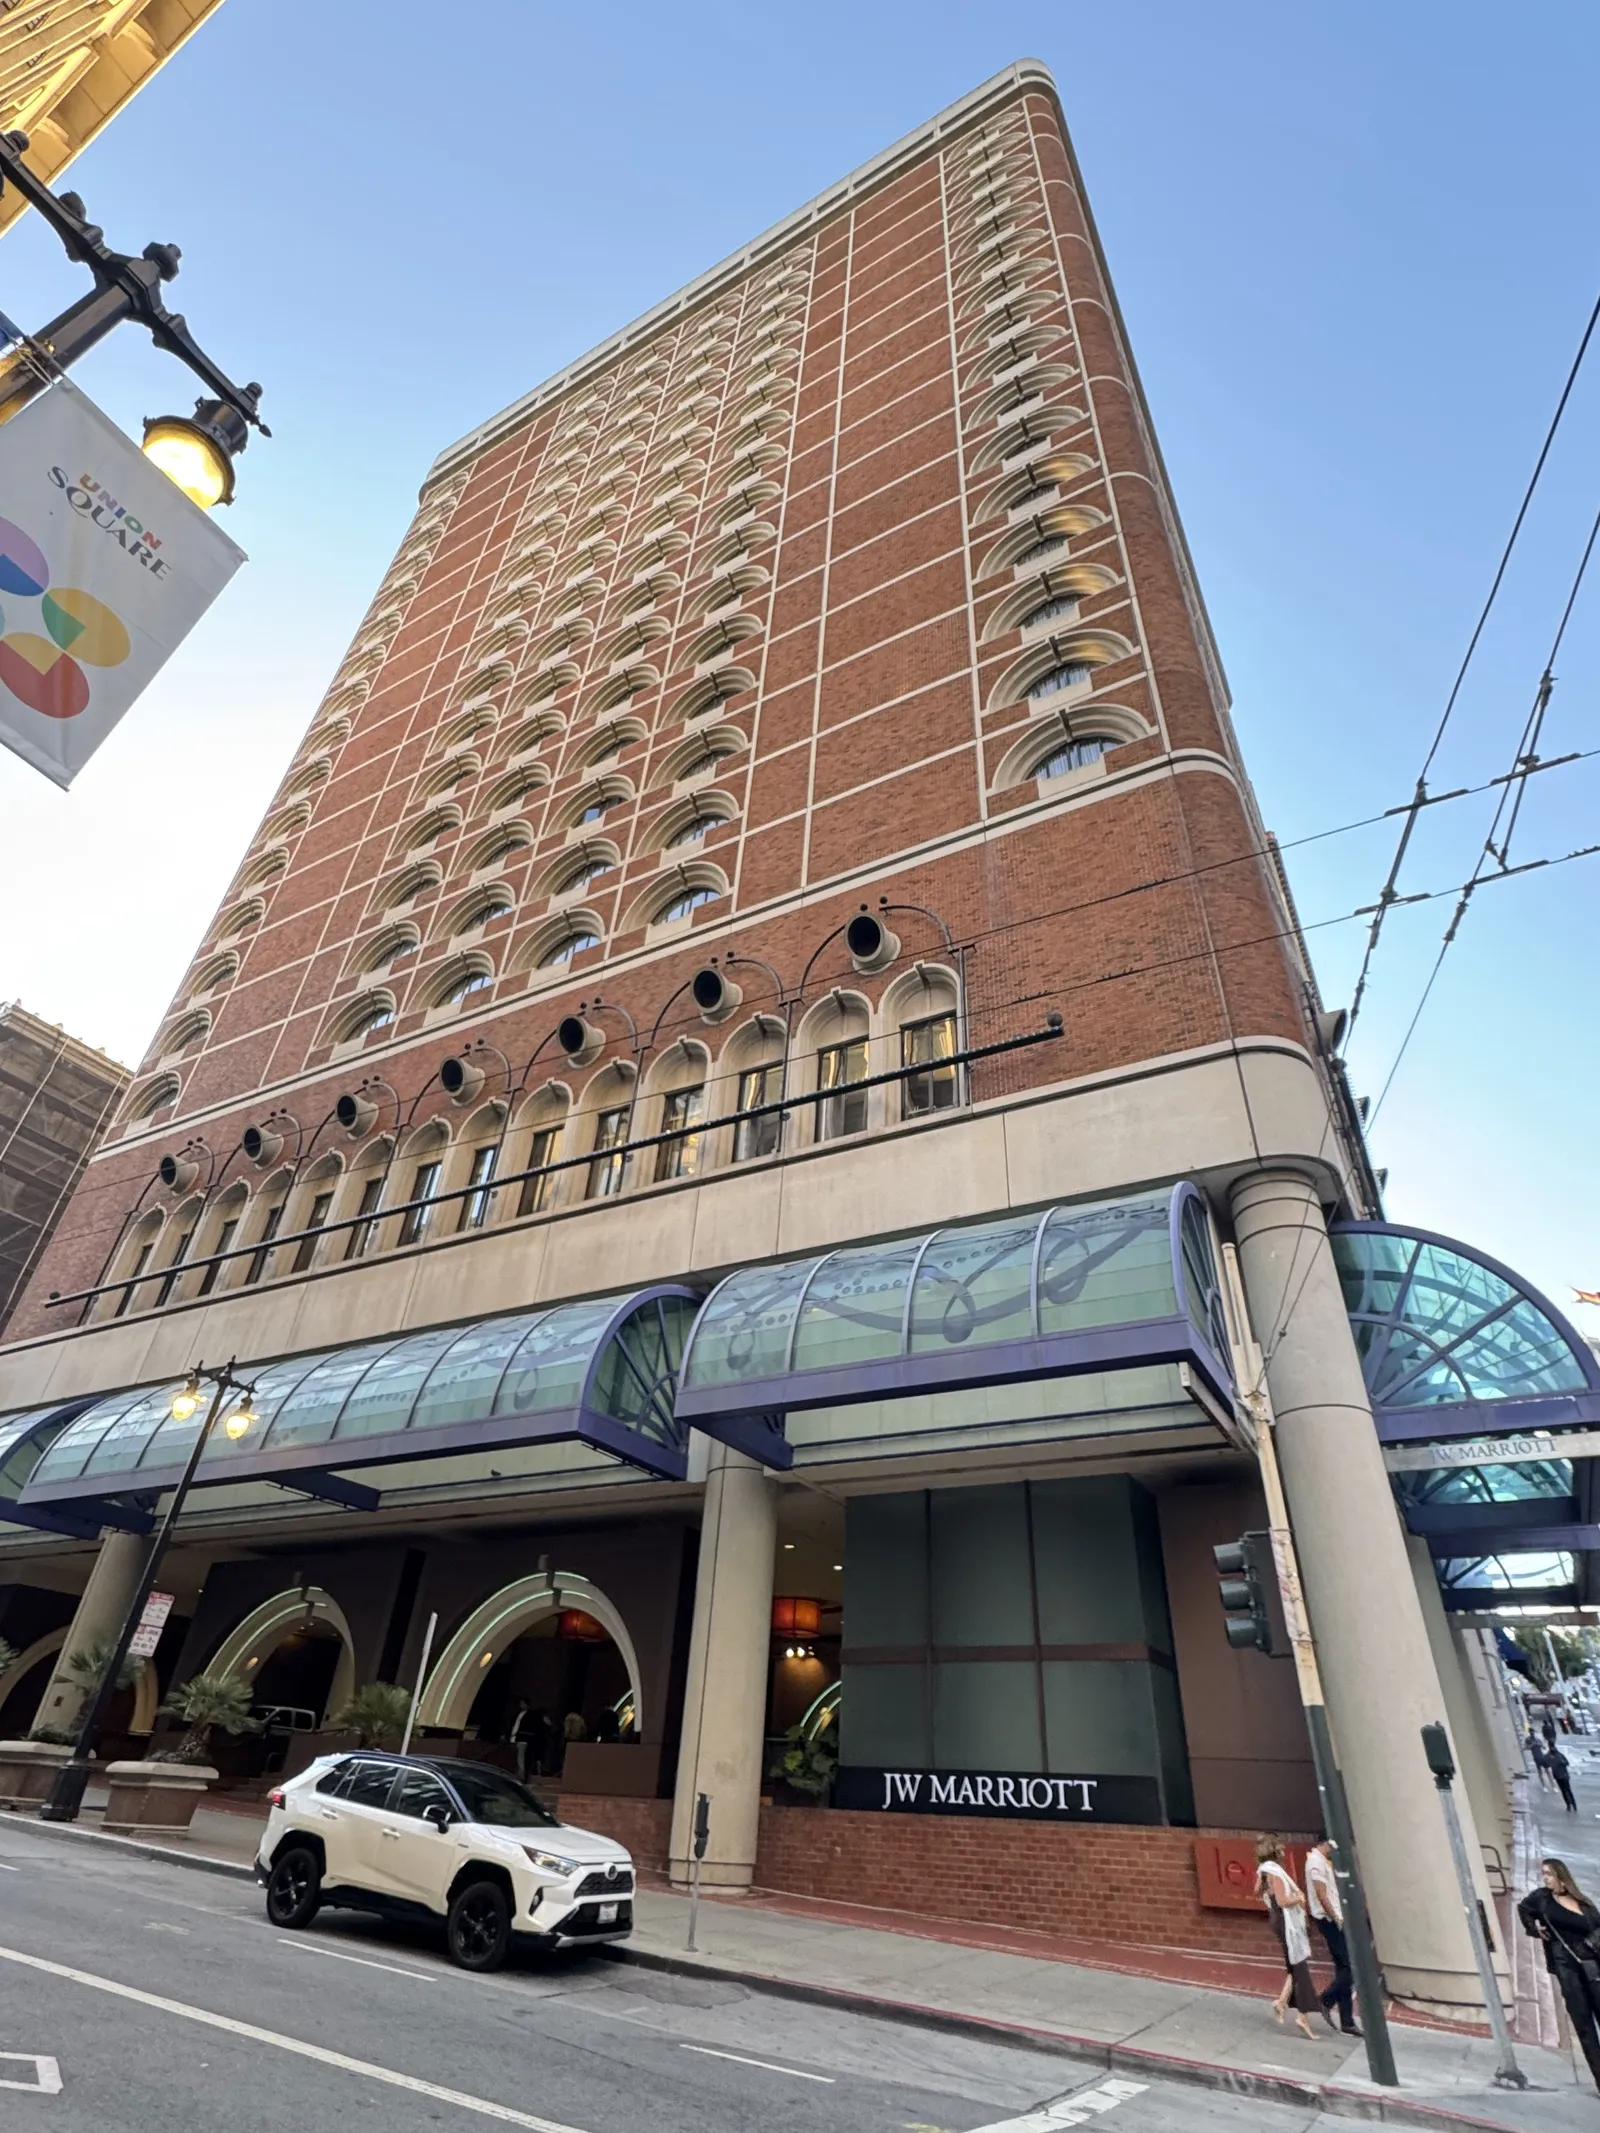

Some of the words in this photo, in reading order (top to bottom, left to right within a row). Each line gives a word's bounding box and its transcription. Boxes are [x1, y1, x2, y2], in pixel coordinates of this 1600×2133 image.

[47, 466, 172, 580] SQUARE
[80, 473, 163, 550] UNION
[1459, 1438, 1557, 1460] MARRIOTT
[882, 1773, 923, 1809] JW
[929, 1774, 1098, 1811] MARRIOTT
